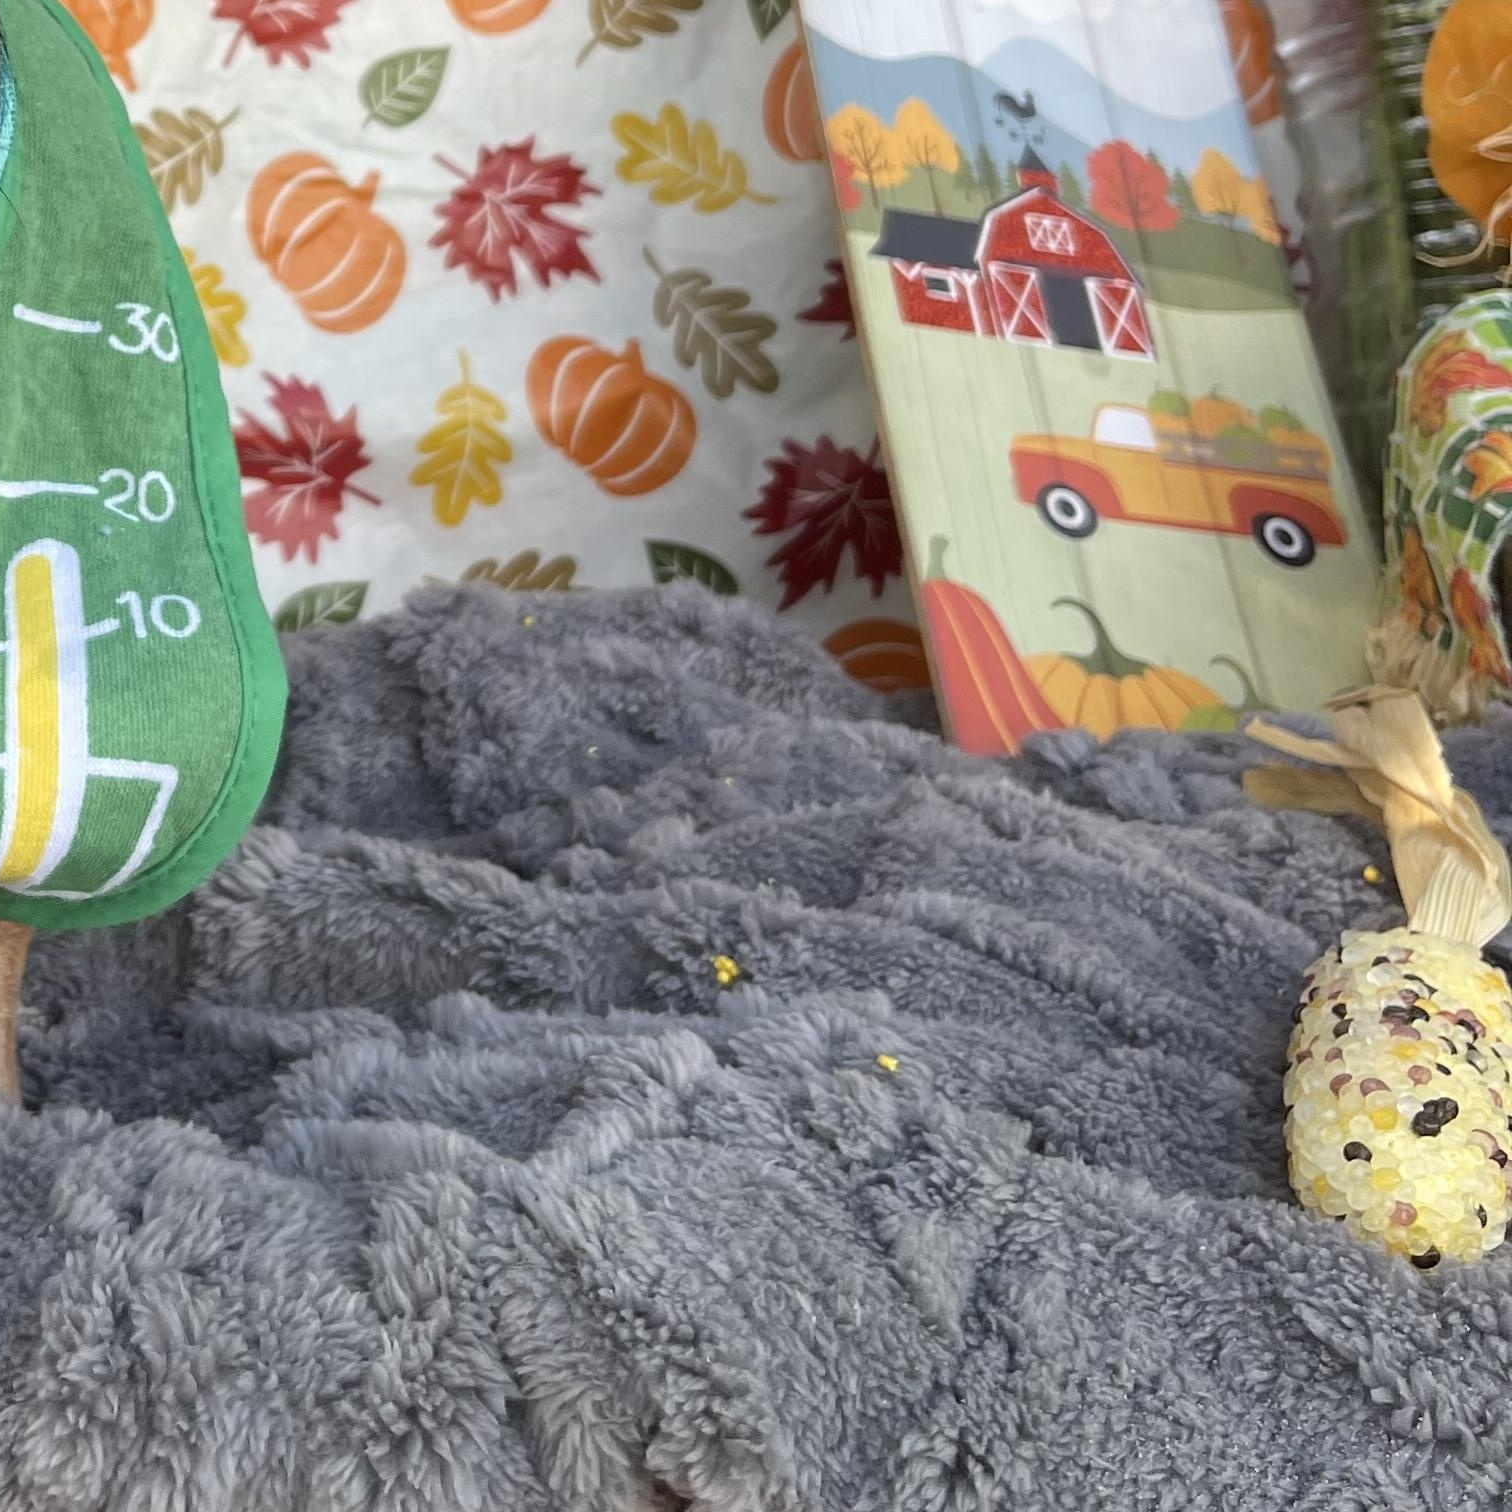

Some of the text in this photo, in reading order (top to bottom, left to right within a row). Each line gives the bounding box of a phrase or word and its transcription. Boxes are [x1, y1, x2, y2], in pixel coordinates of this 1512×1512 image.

[108, 303, 180, 362] 30
[99, 467, 176, 522] 20
[115, 591, 201, 638] 10
